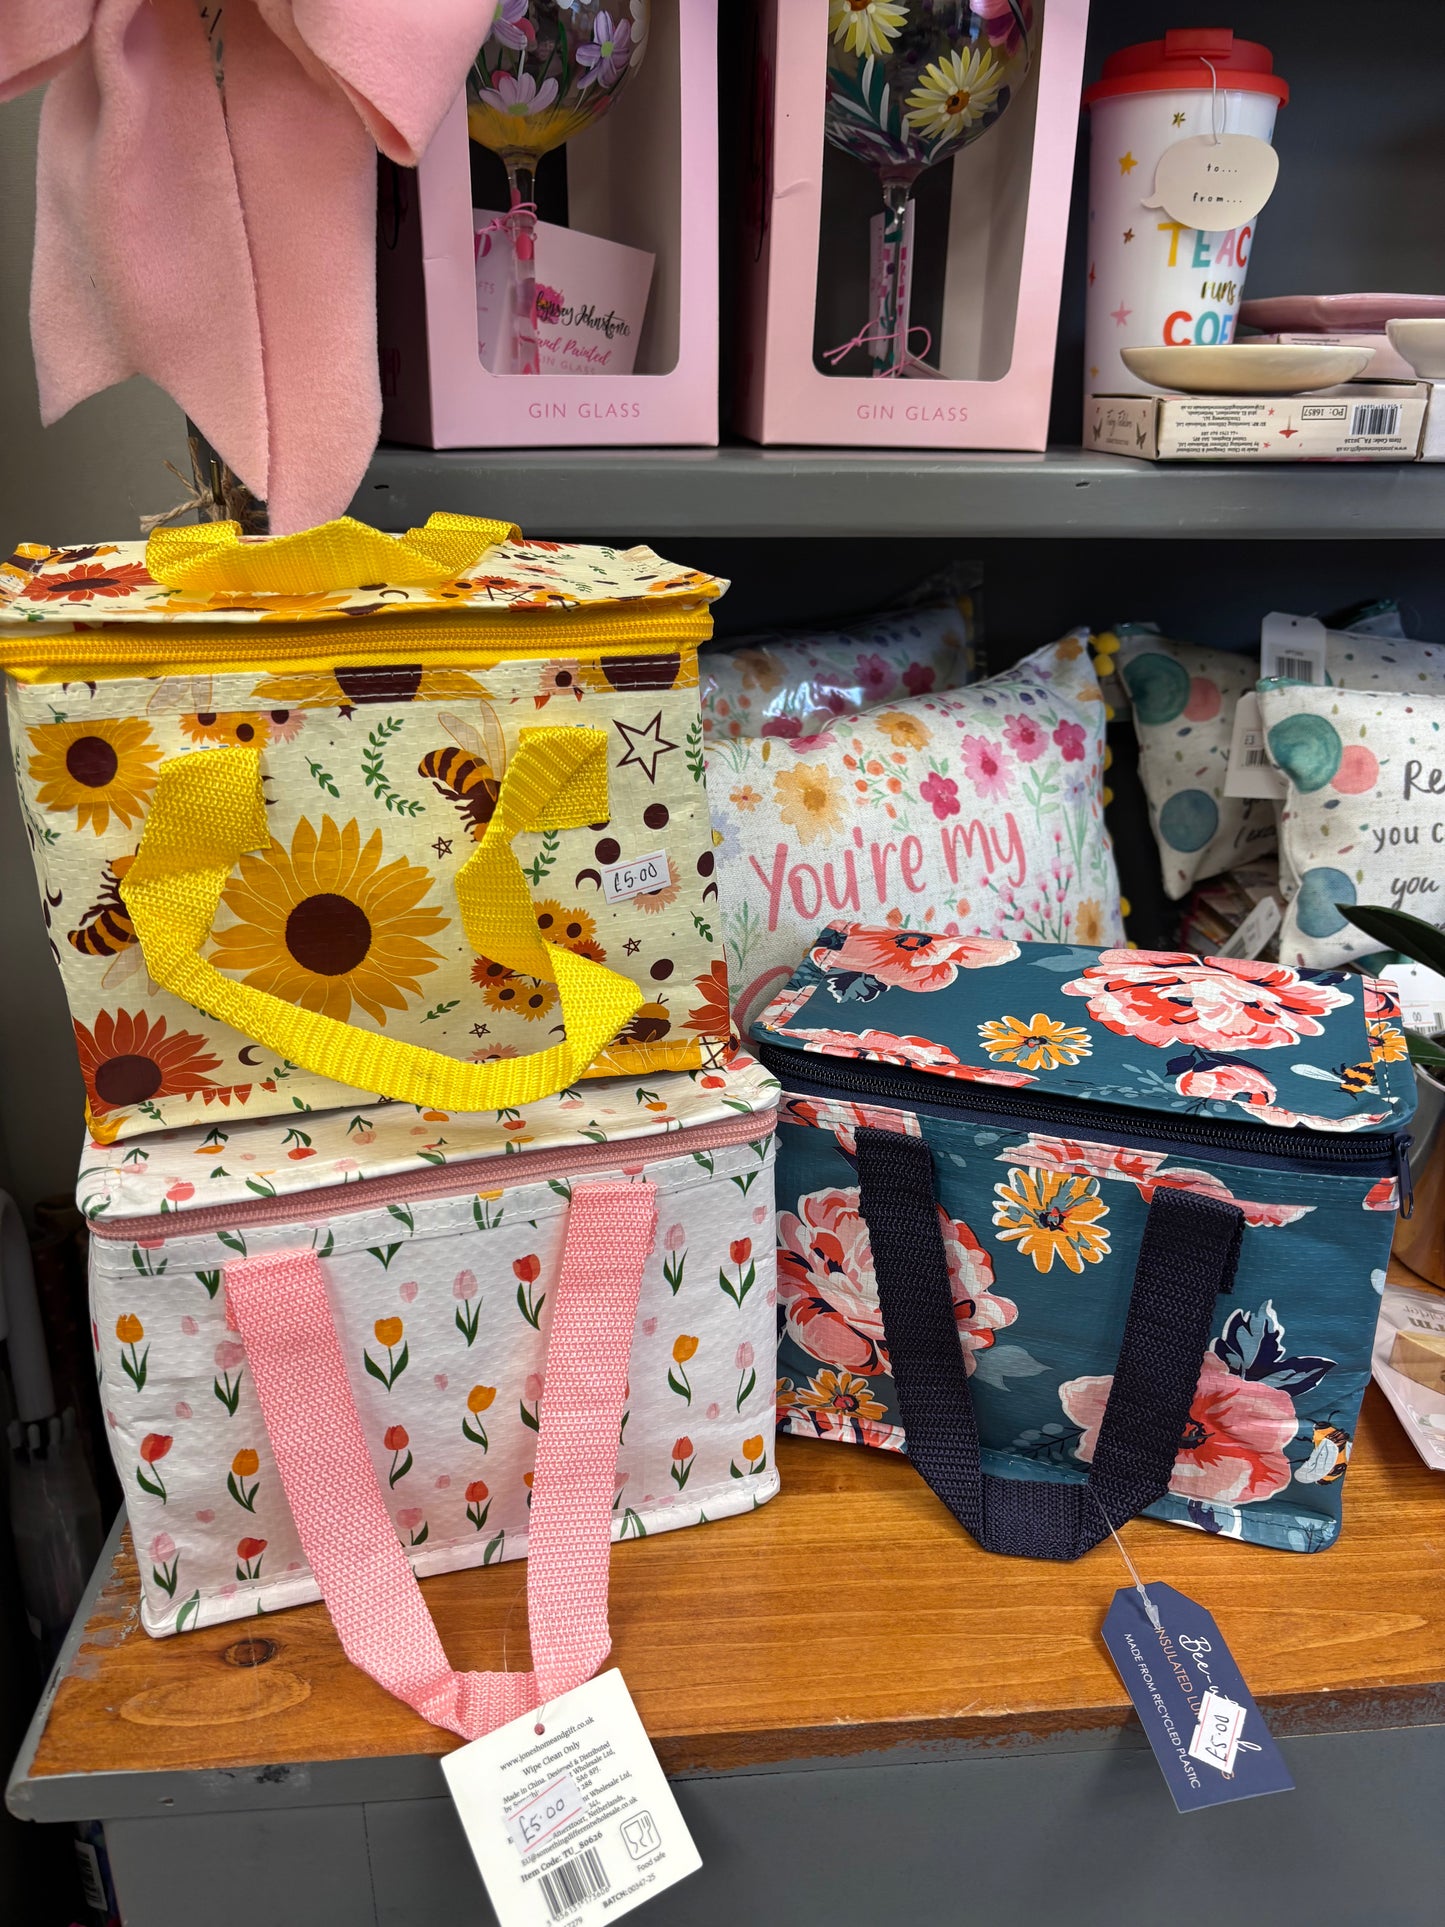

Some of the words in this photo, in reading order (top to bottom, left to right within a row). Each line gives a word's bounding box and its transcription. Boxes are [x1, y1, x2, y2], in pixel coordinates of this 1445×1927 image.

[1207, 164, 1238, 173] to...
[1193, 193, 1243, 203] from...
[1201, 281, 1239, 305] runs
[537, 337, 562, 353] and
[529, 403, 567, 419] GIN
[578, 402, 641, 419] GLASS
[856, 405, 894, 420] GIN
[905, 406, 969, 422] GLASS
[1304, 408, 1324, 416] 16857
[1329, 408, 1344, 416] PO:
[1372, 826, 1419, 853] you
[614, 862, 658, 893] £5.00
[749, 827, 924, 932] You're
[939, 812, 1028, 888] my
[1391, 877, 1440, 911] you
[1154, 1626, 1192, 1692] INSULATED
[1124, 1634, 1143, 1661] MADE
[1138, 1664, 1156, 1691] FROM
[1152, 1694, 1181, 1745] RECYCLED
[1177, 1748, 1200, 1788] PLASTIC
[500, 1717, 594, 1770] www.joneshomeandgift.co.uk
[523, 1763, 541, 1775] Wipe
[543, 1752, 563, 1765] Clean
[563, 1741, 579, 1754] Only
[571, 1756, 602, 1774] Wholesale
[503, 1792, 520, 1804] Made
[579, 1741, 611, 1762] Distributed
[576, 1772, 588, 1783] SA6
[589, 1778, 619, 1797] Wholesale
[519, 1799, 565, 1843] £5.00
[521, 1797, 638, 1866] EU@somethingdifferentwholesale.co.uk
[521, 1869, 540, 1883] Item
[541, 1856, 562, 1871] Code:
[562, 1831, 603, 1858] TU_80626
[637, 1859, 653, 1872] Food
[653, 1852, 665, 1862] safe
[603, 1891, 629, 1908] BATCH:
